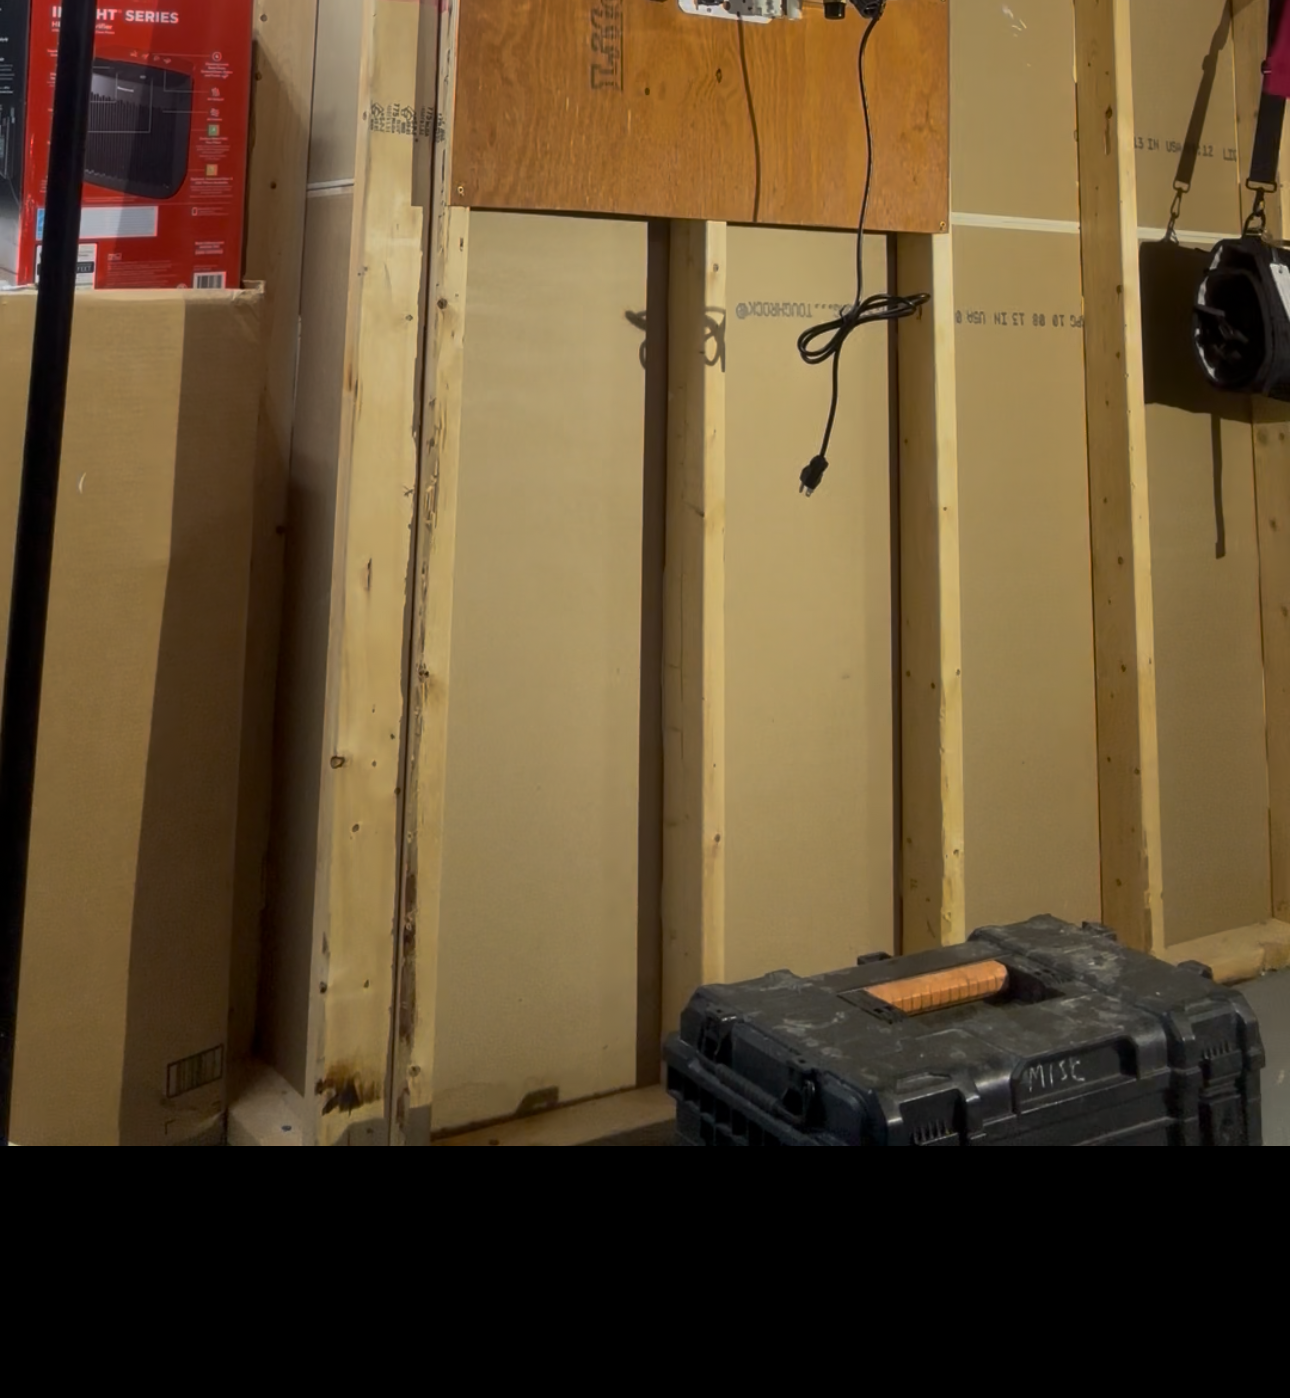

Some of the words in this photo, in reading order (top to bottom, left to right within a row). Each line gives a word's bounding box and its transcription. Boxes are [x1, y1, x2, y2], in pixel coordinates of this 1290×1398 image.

[125, 9, 179, 24] SERIES
[966, 310, 986, 325] USA
[993, 311, 1007, 326] IN
[1011, 312, 1025, 326] 13
[1051, 314, 1065, 327] 10
